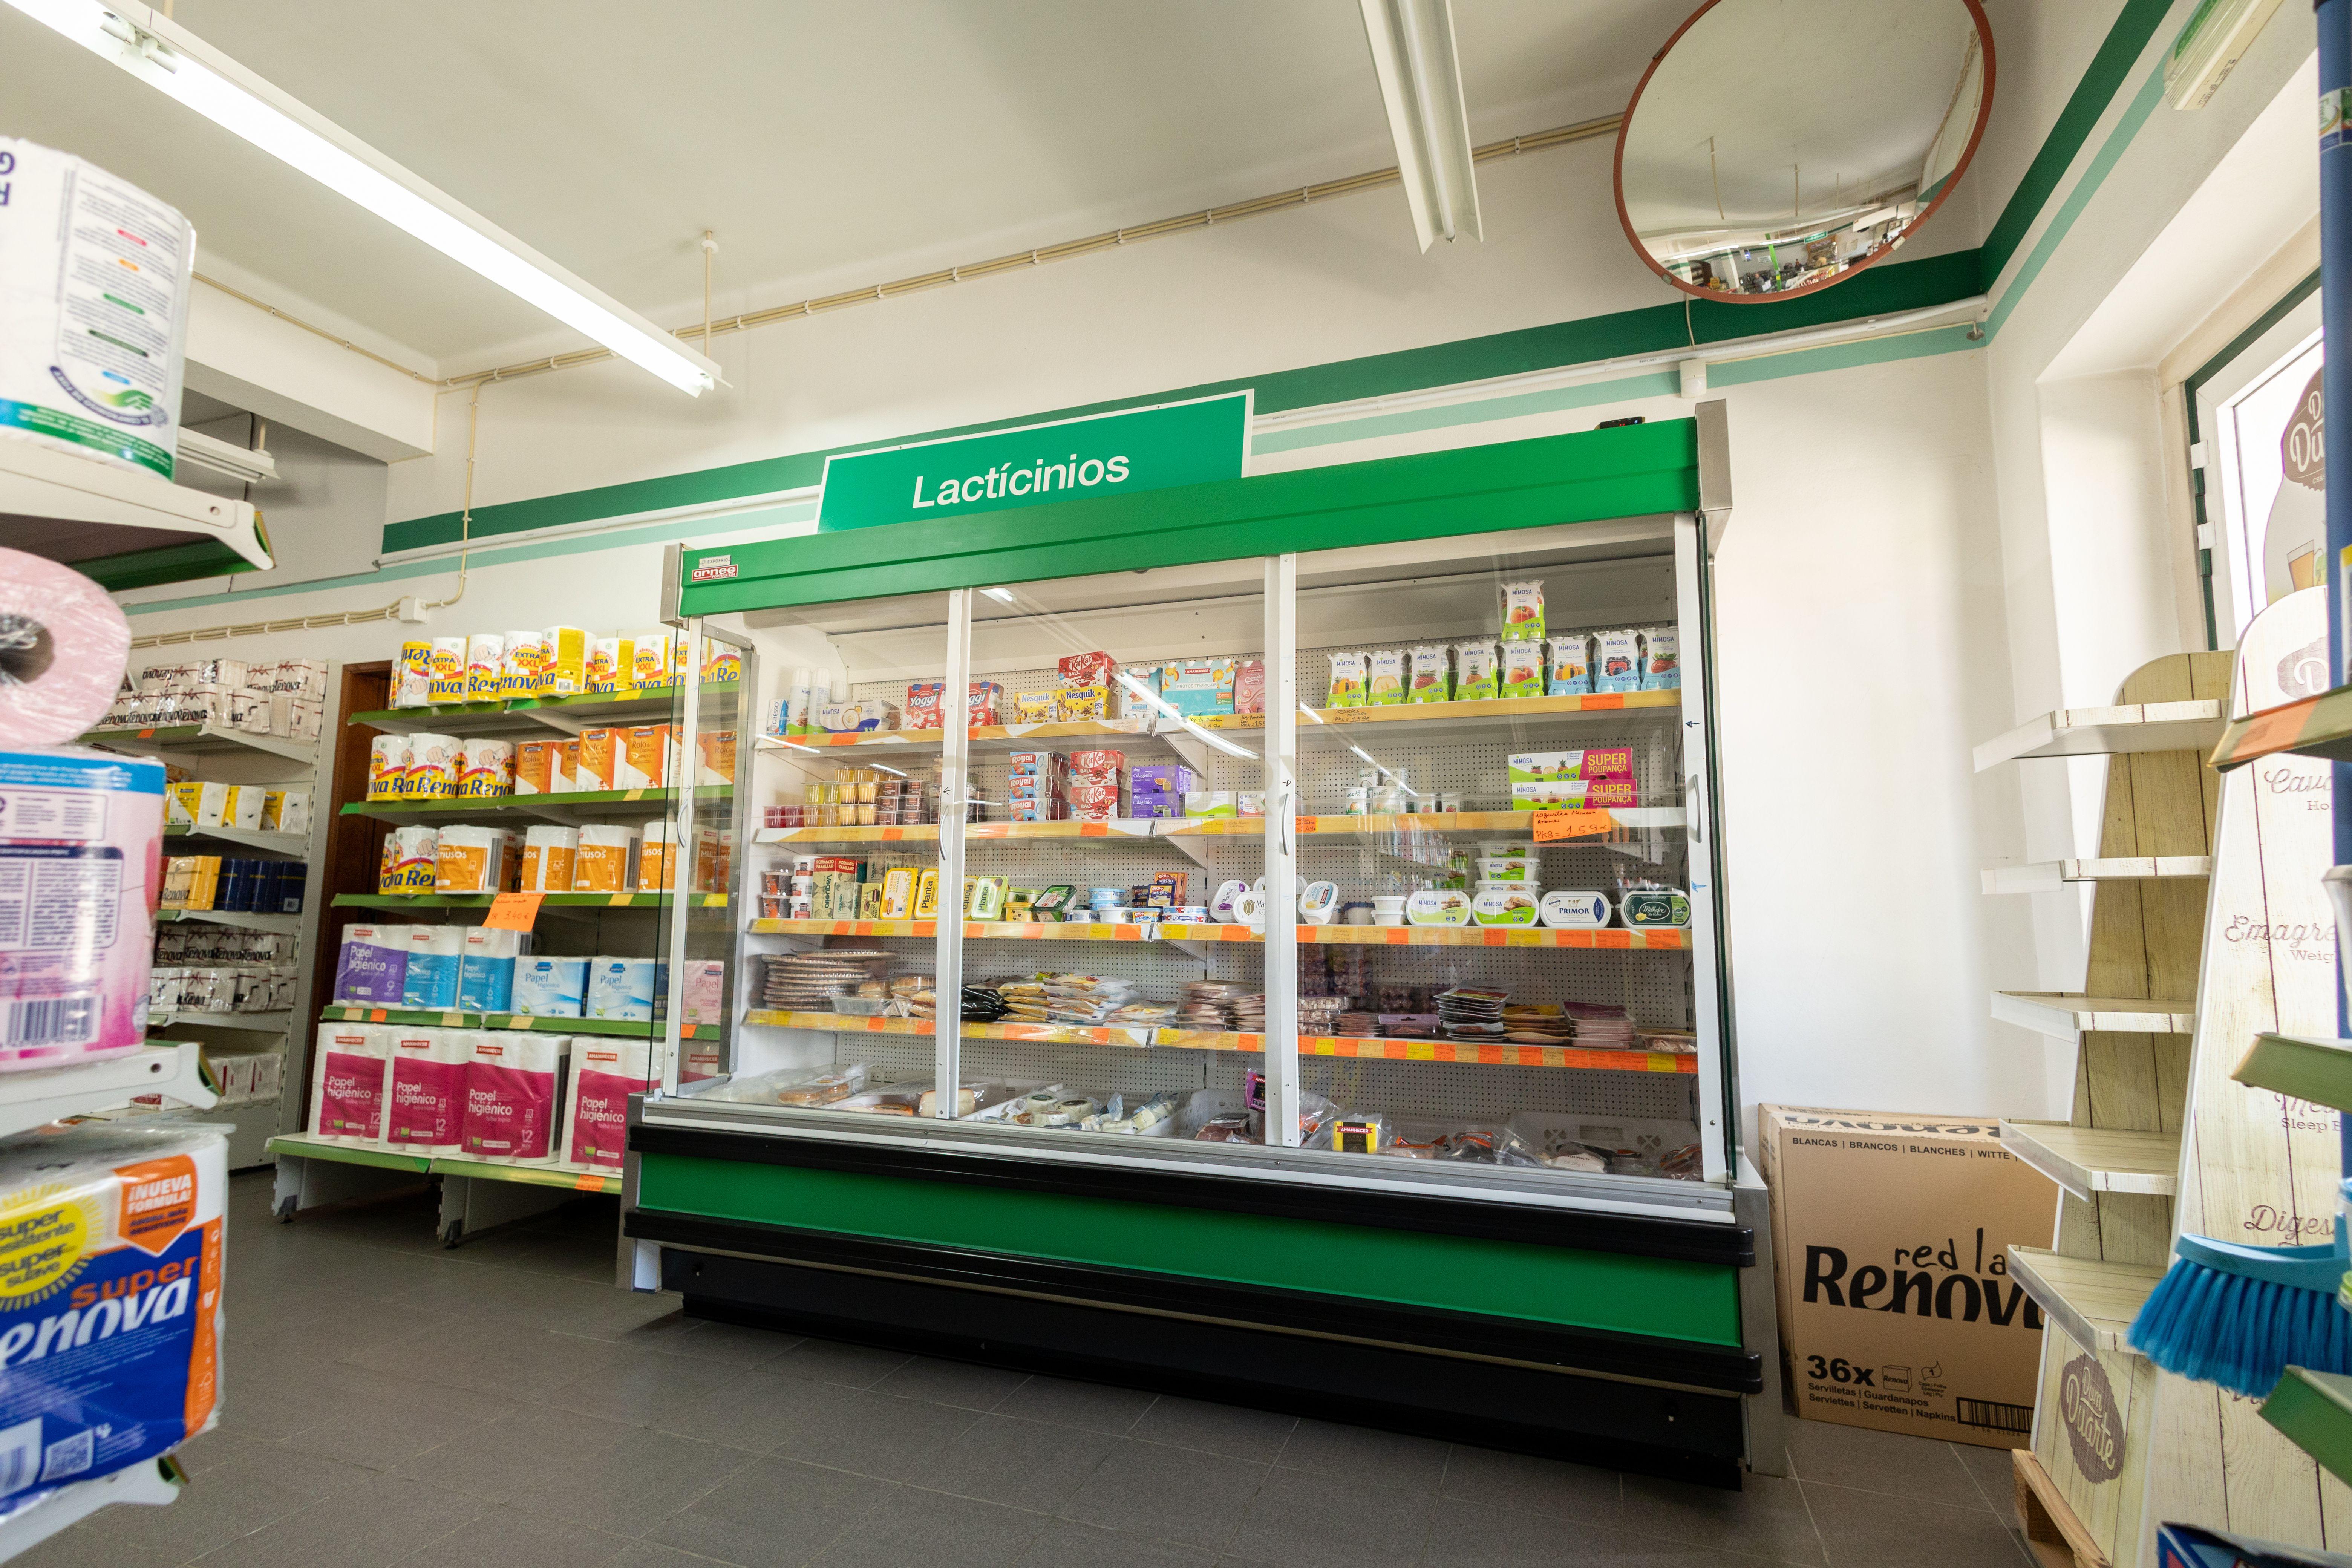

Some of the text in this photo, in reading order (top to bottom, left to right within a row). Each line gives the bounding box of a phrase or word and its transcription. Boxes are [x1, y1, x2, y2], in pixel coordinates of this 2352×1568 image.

[912, 454, 1130, 509] Lactícinios
[1072, 655, 1092, 670] KitKat
[910, 695, 937, 707] Yoggi
[1022, 693, 1050, 704] Nesquik
[1066, 689, 1095, 700] Nesquik
[1012, 754, 1033, 763] Royal
[1084, 753, 1104, 768] KitKat
[1588, 753, 1626, 766] SUPER
[1588, 764, 1627, 773] POUPANÇA
[1010, 778, 1031, 787] Royal
[1592, 784, 1631, 795] SUPER
[1084, 789, 1105, 804] KitKat
[1593, 795, 1632, 804] POUPANÇA
[1011, 801, 1032, 811] Royal
[921, 880, 933, 908] Planta
[963, 885, 974, 910] Planta
[977, 886, 989, 911] Planta
[1222, 887, 1233, 903] Matinal
[2225, 915, 2336, 948] Emagre
[350, 945, 373, 957] Papel
[525, 972, 548, 984] Papel
[600, 975, 622, 986] Papel
[696, 977, 719, 990] Papel
[387, 981, 395, 991] 9
[329, 1076, 355, 1089] Papel
[397, 1081, 422, 1095] Papel
[328, 1086, 371, 1099] higiénico
[396, 1092, 436, 1106] higiénico
[470, 1088, 496, 1103] Papel
[469, 1100, 513, 1116] higiénico
[582, 1096, 608, 1110] Papel
[370, 1112, 380, 1124] 12
[580, 1108, 625, 1123] higiénico
[436, 1118, 446, 1131] 12
[2281, 1117, 2327, 1134] Sleep
[522, 1130, 533, 1143] 12
[1792, 1138, 2010, 1160] BLANCAS BRANCOS BLANCHES WITTE
[1894, 1238, 1958, 1272] red
[69, 1256, 198, 1309] super
[0, 1277, 192, 1370] enova
[1807, 1354, 1876, 1387] 36x
[1808, 1383, 1929, 1407] Servilletas Guardanapos
[2082, 1366, 2103, 1410] Dom
[1809, 1393, 1956, 1423] Serviettes Servetten Napkins
[2066, 1374, 2115, 1470] Duarte
